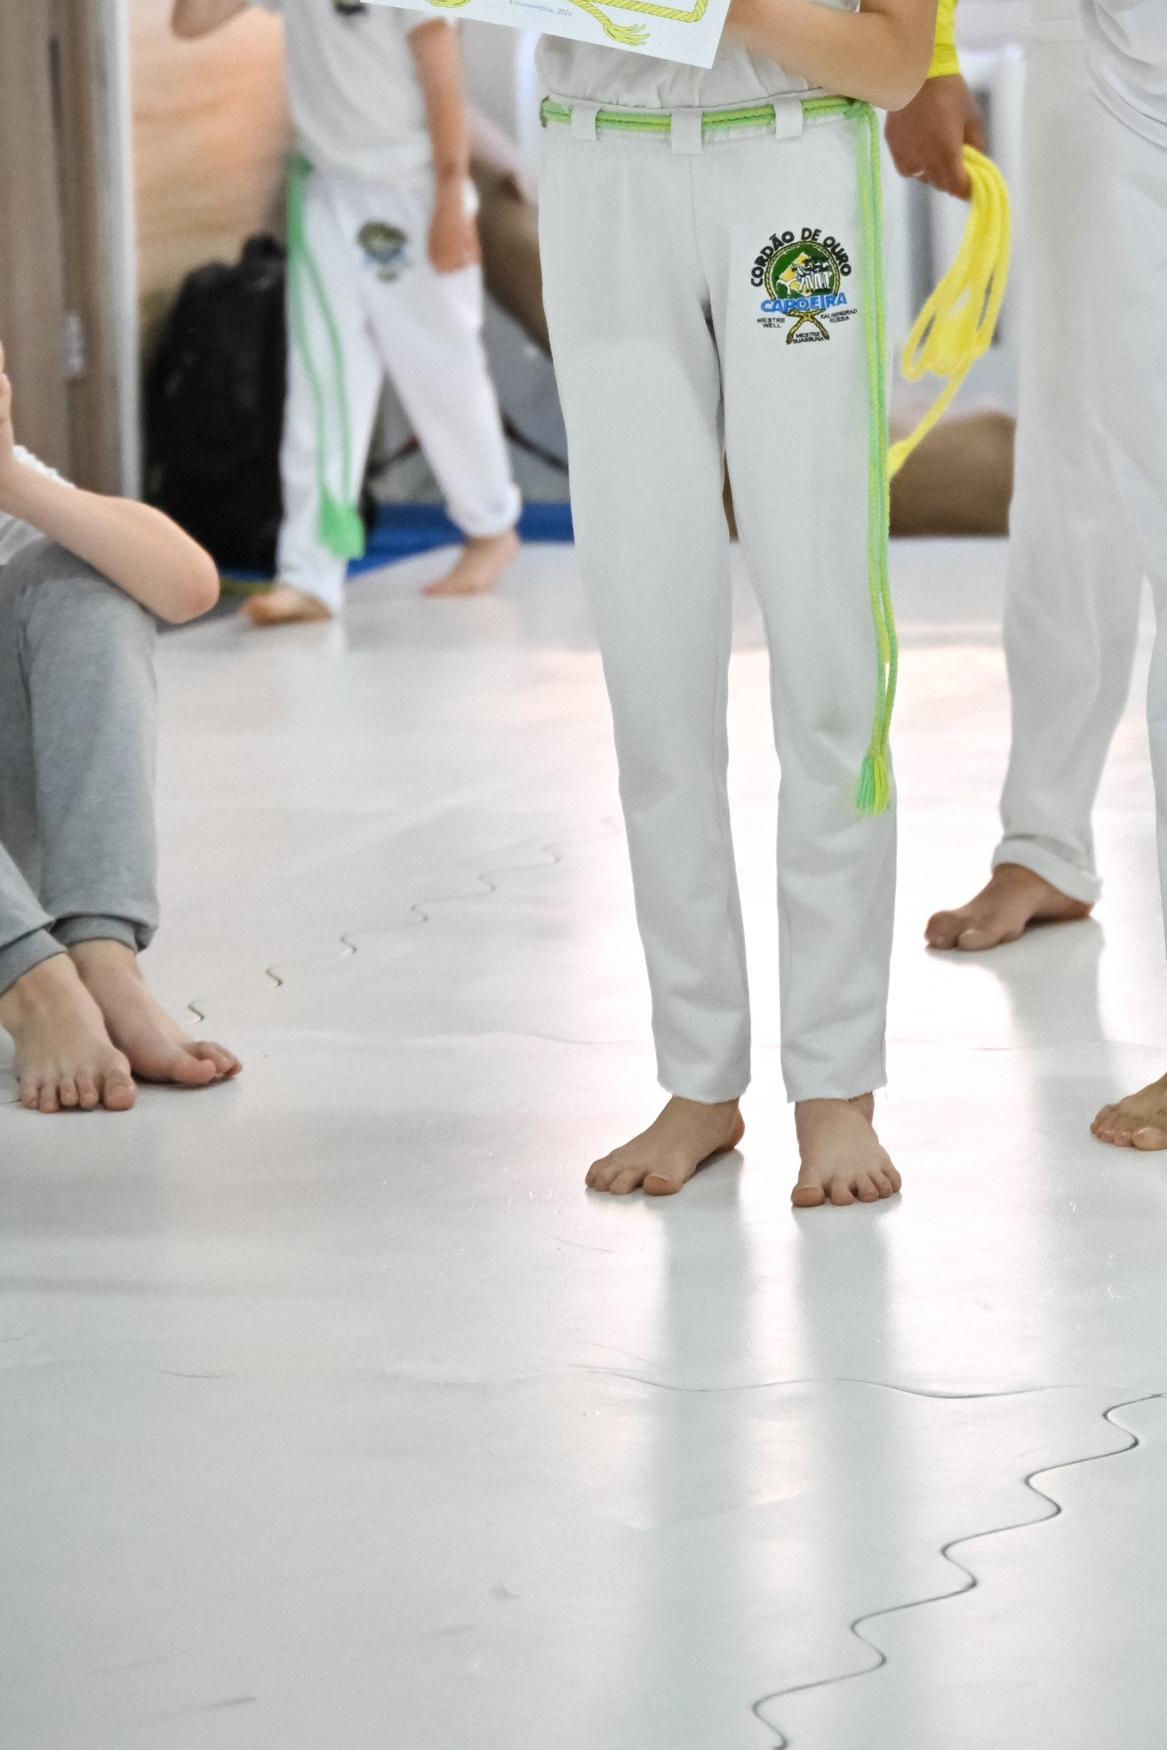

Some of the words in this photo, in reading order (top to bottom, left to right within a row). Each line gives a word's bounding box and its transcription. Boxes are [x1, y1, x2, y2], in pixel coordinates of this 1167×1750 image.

[751, 231, 795, 287] CORDÃO
[801, 227, 822, 241] DE
[823, 236, 852, 277] OURO
[760, 292, 847, 313] CAPOEIRA
